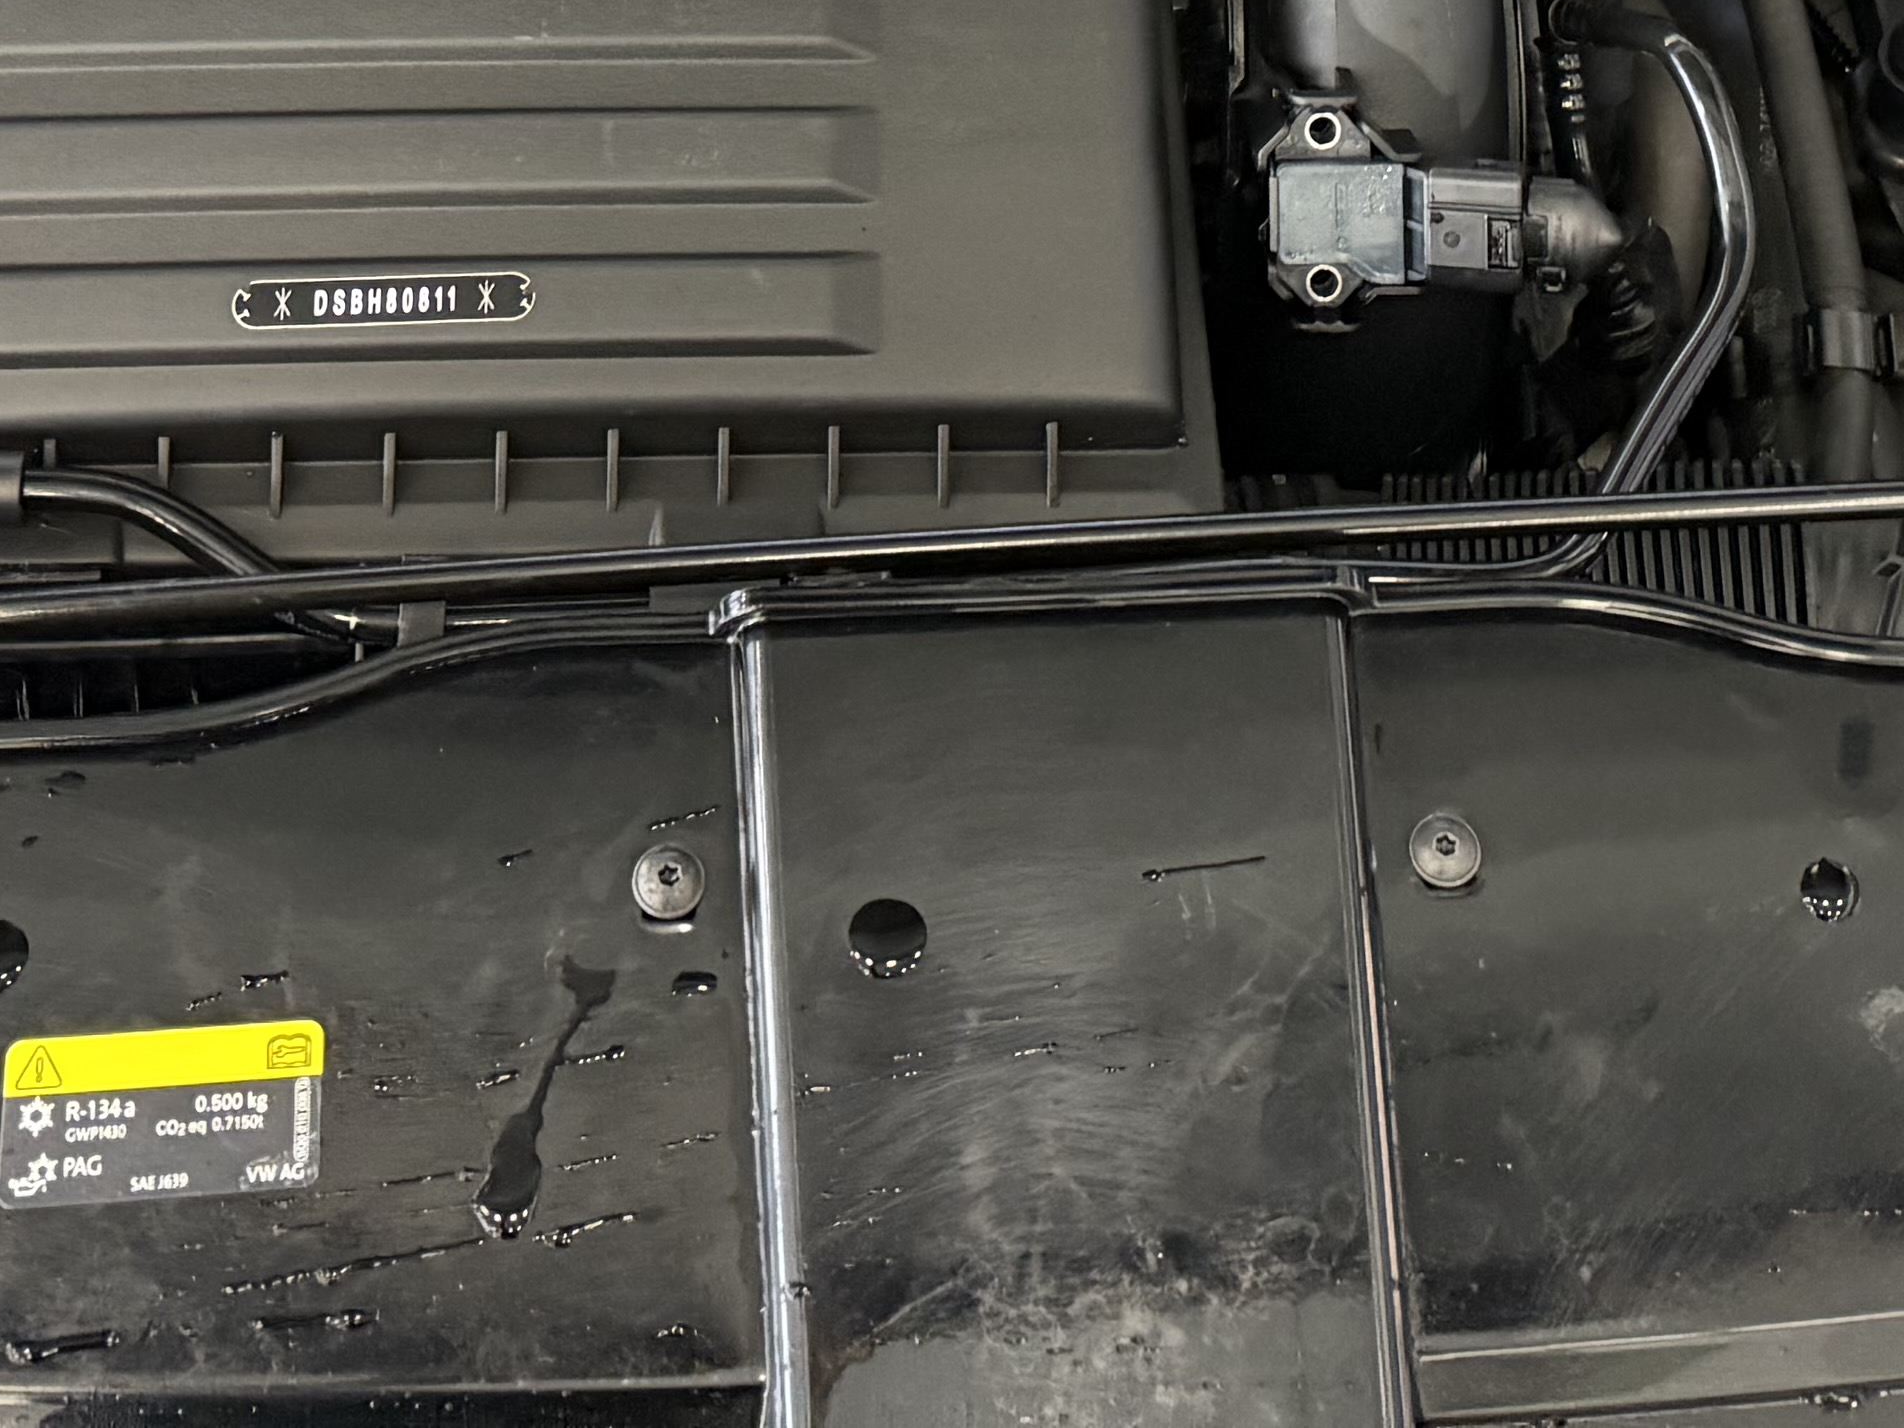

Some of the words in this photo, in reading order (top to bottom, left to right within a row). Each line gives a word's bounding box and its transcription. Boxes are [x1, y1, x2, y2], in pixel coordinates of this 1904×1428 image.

[195, 1093, 243, 1113] 0.500
[247, 1091, 268, 1113] kg
[63, 1155, 103, 1177] PAG
[130, 1174, 156, 1192] SAE
[246, 1163, 278, 1183] VW
[279, 1162, 305, 1181] AG
